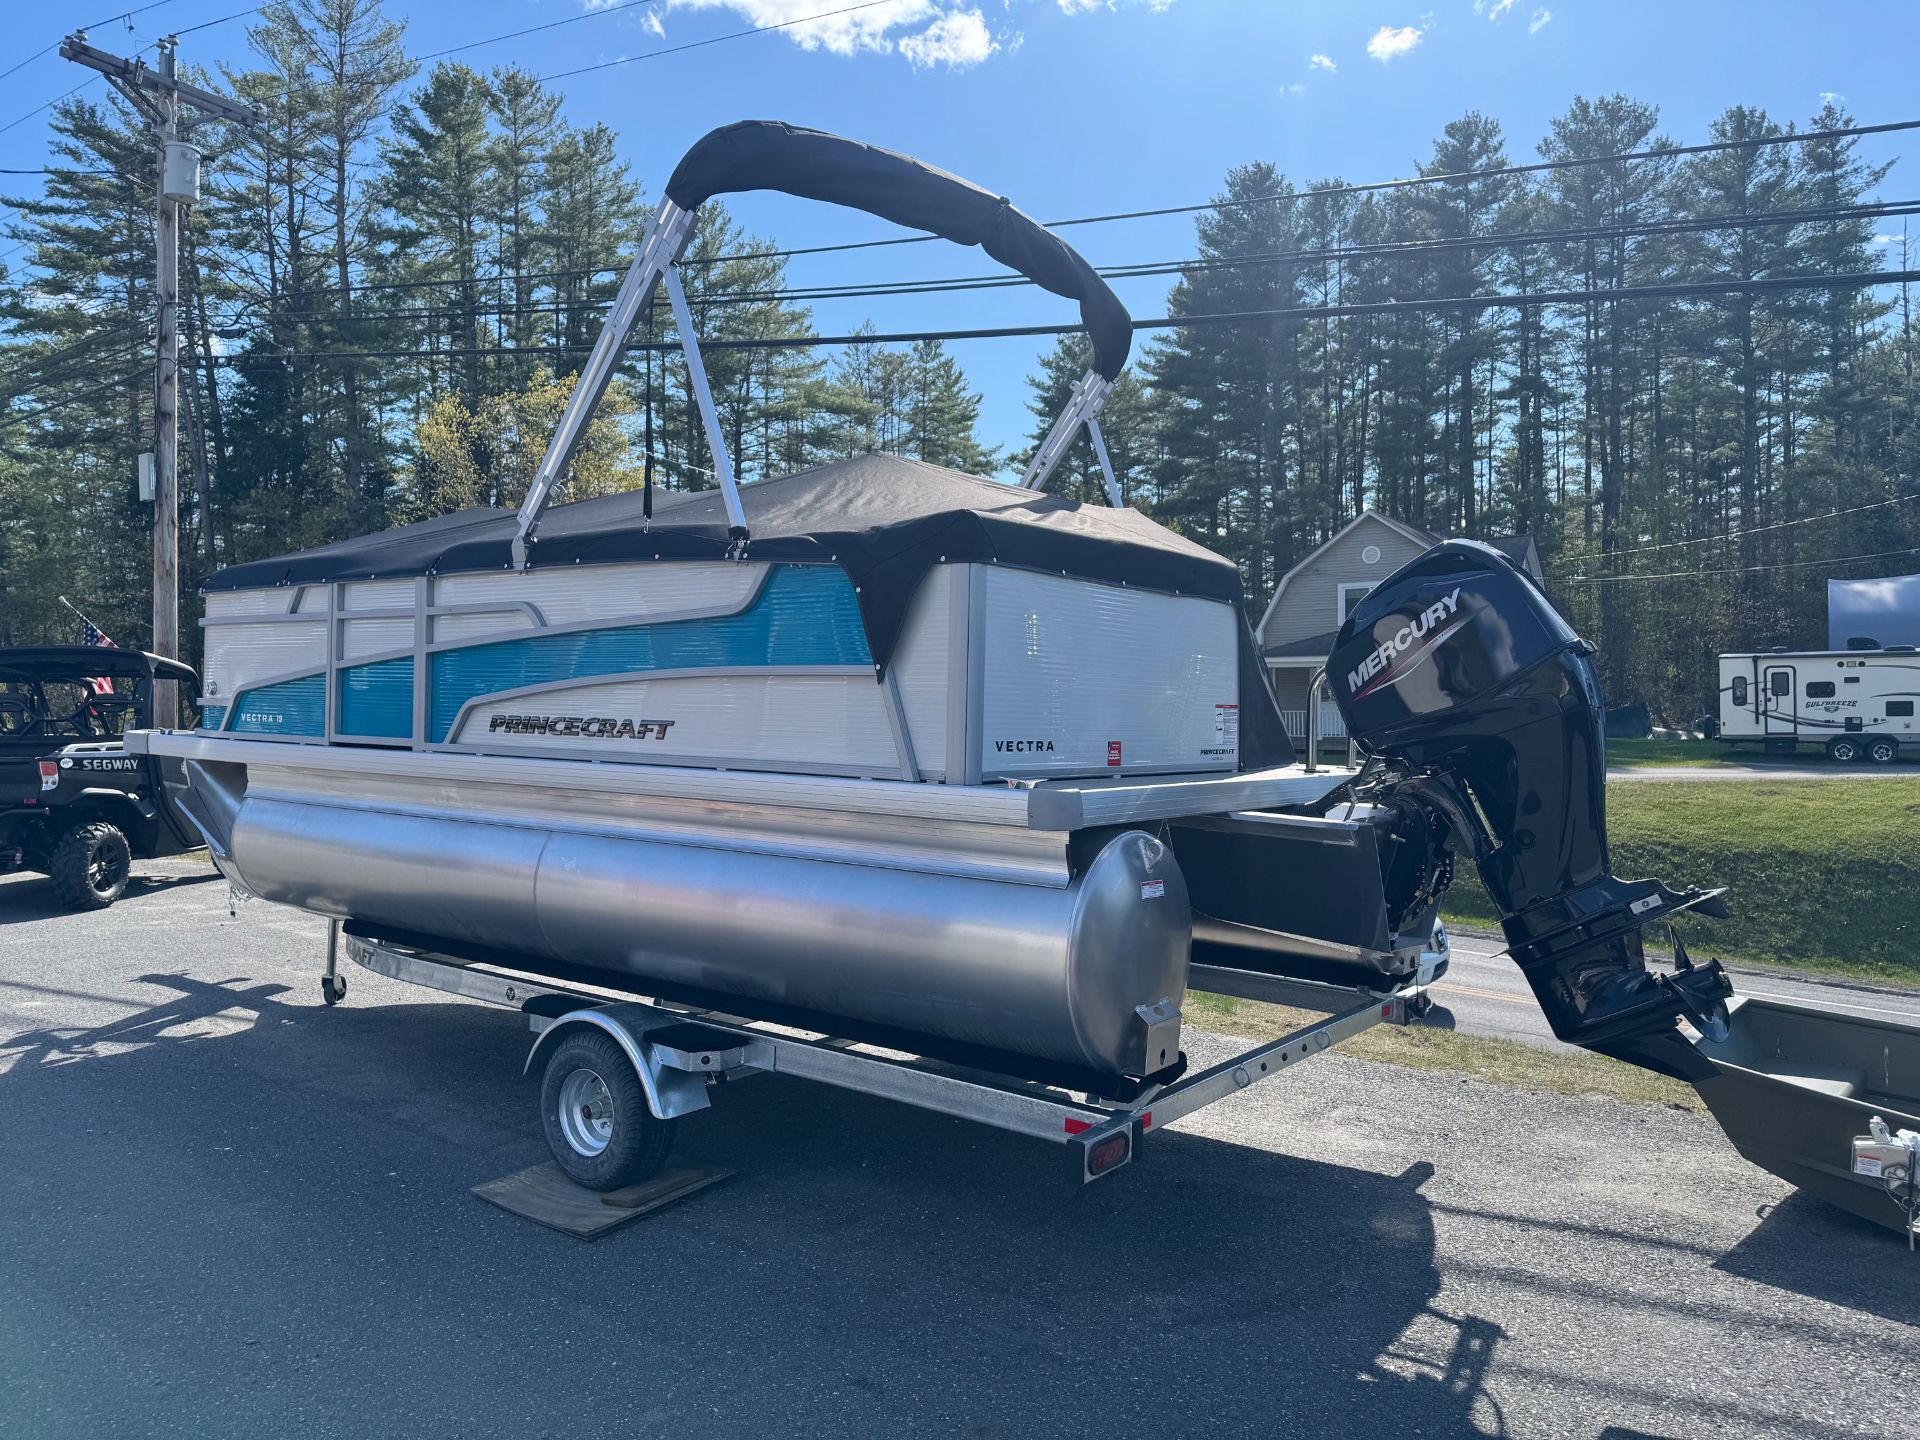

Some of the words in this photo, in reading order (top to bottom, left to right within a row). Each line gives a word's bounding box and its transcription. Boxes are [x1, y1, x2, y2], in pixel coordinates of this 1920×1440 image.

[1347, 587, 1460, 693] MERCURY
[241, 713, 273, 723] VECTRA
[276, 714, 283, 723] 19
[489, 714, 675, 740] PRINCECRAFT
[995, 740, 1055, 752] VECTRA
[82, 759, 139, 771] SEGWAY
